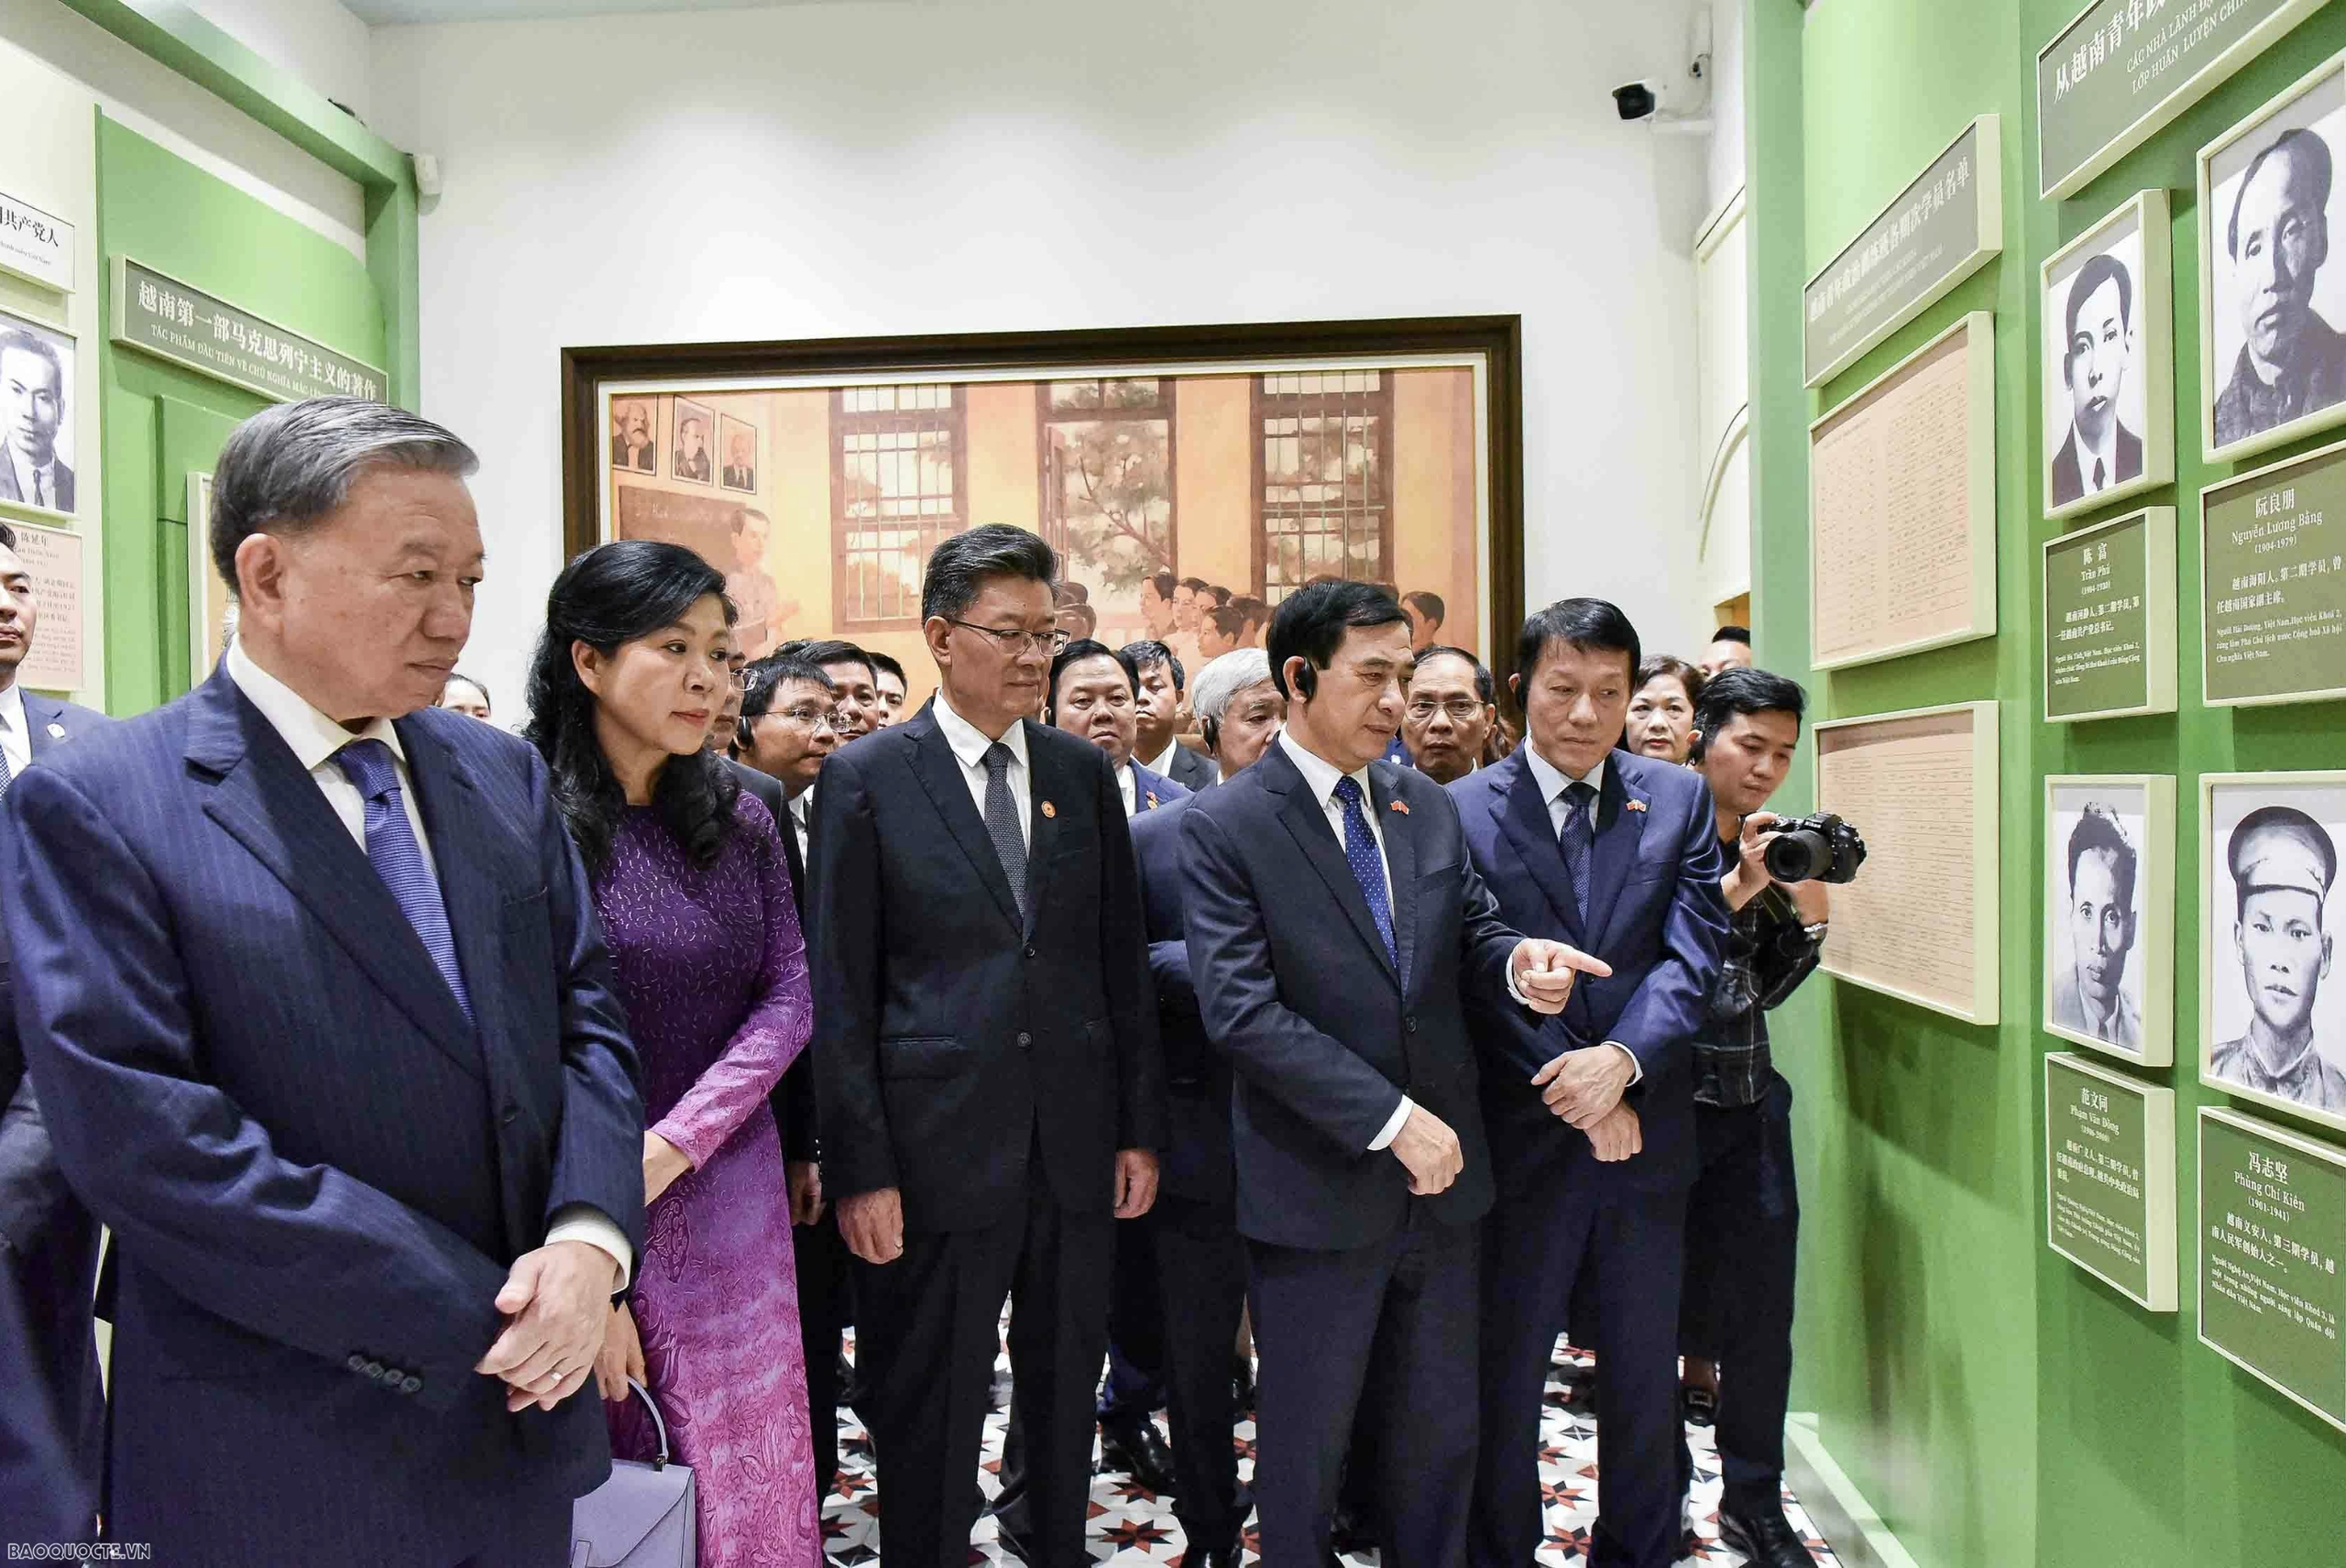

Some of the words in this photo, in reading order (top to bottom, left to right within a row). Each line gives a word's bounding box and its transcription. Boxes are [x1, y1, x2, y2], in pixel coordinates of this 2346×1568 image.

[2183, 13, 2217, 53] LUYỆN
[2127, 49, 2144, 72] CÁC
[2146, 28, 2167, 58] NHÀ
[0, 206, 59, 247] 共产党人
[139, 280, 373, 400] 越南第一部马克思列宁主义的著作
[151, 323, 168, 340] TÁC
[2255, 488, 2294, 518] 阮良朋
[2267, 517, 2296, 534] Lương
[2254, 534, 2297, 553] (1904-1979)
[2249, 1152, 2287, 1184] 冯志坚
[2234, 1171, 2262, 1196] Phùng
[2283, 1191, 2305, 1212] Kiên
[2248, 1196, 2289, 1223] (1901-1941)
